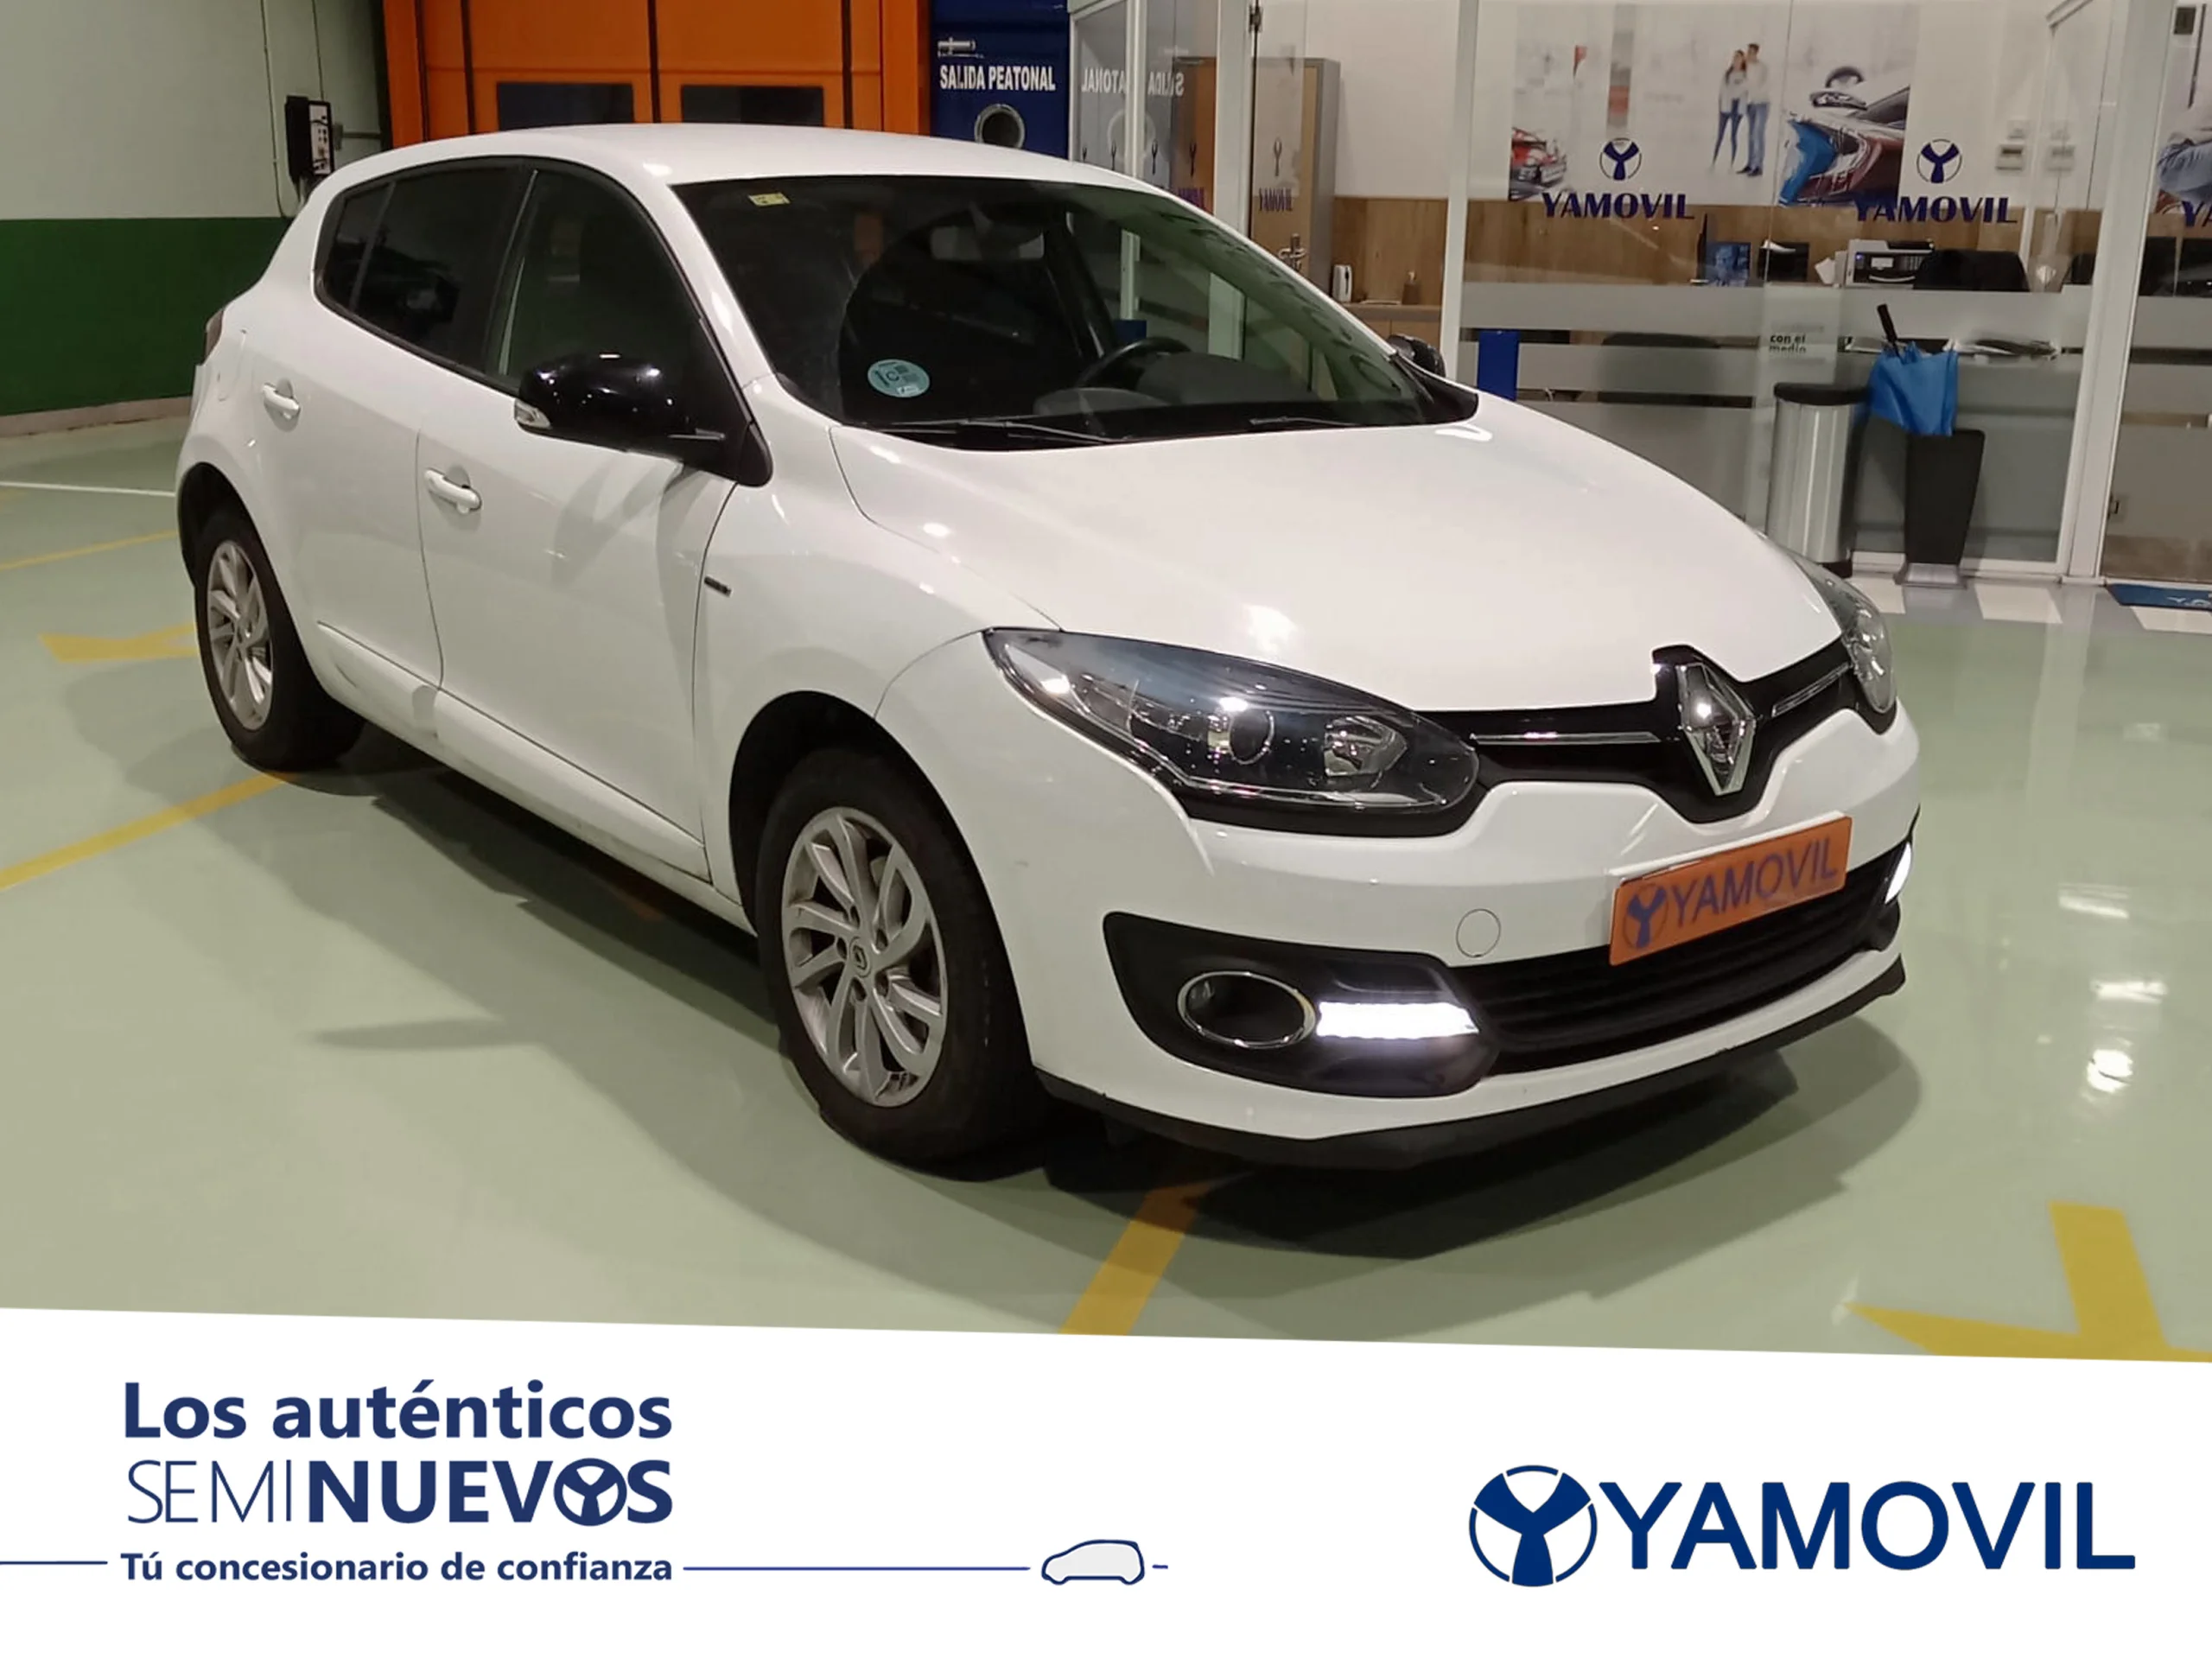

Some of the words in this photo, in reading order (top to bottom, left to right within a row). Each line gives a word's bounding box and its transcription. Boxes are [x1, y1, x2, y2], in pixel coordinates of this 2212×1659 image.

[940, 65, 986, 91] SALIDA
[988, 66, 1056, 92] PEATONAL
[1541, 192, 1695, 219] YAMOVIL
[1853, 195, 2018, 224] YAMOVIL
[1770, 334, 1791, 344] con
[1671, 836, 1838, 929] YAMOVIL
